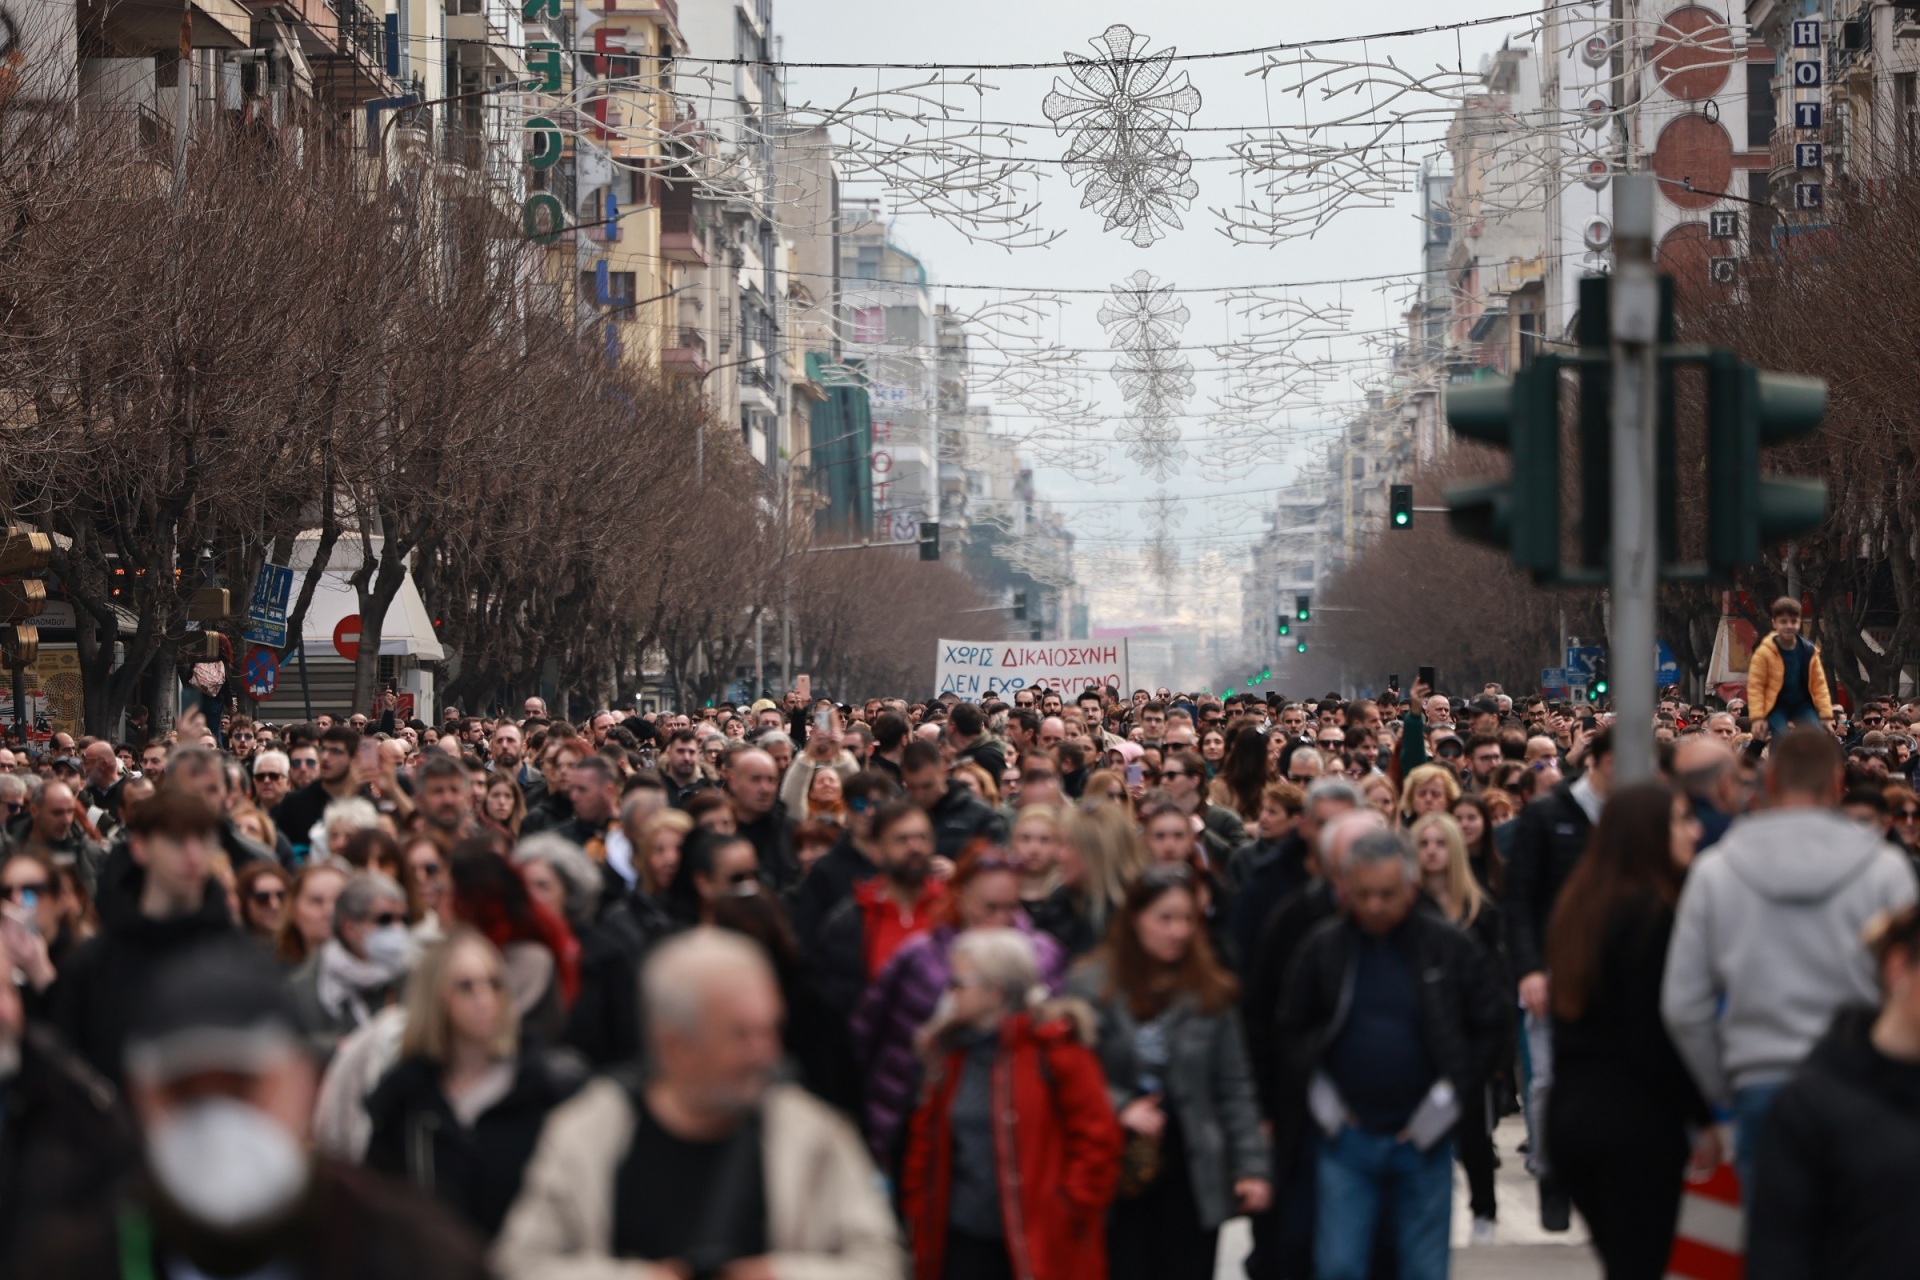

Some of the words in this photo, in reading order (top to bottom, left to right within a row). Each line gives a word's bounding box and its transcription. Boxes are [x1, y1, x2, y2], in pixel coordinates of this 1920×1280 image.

[594, 0, 628, 141] EL
[1796, 23, 1818, 207] HOTEL
[940, 673, 981, 693] ΔΕΝ
[944, 645, 994, 668] ΧΩΡΙΣ
[1001, 645, 1117, 668] ΔΙΚΑΙΟΣΥΝΗ
